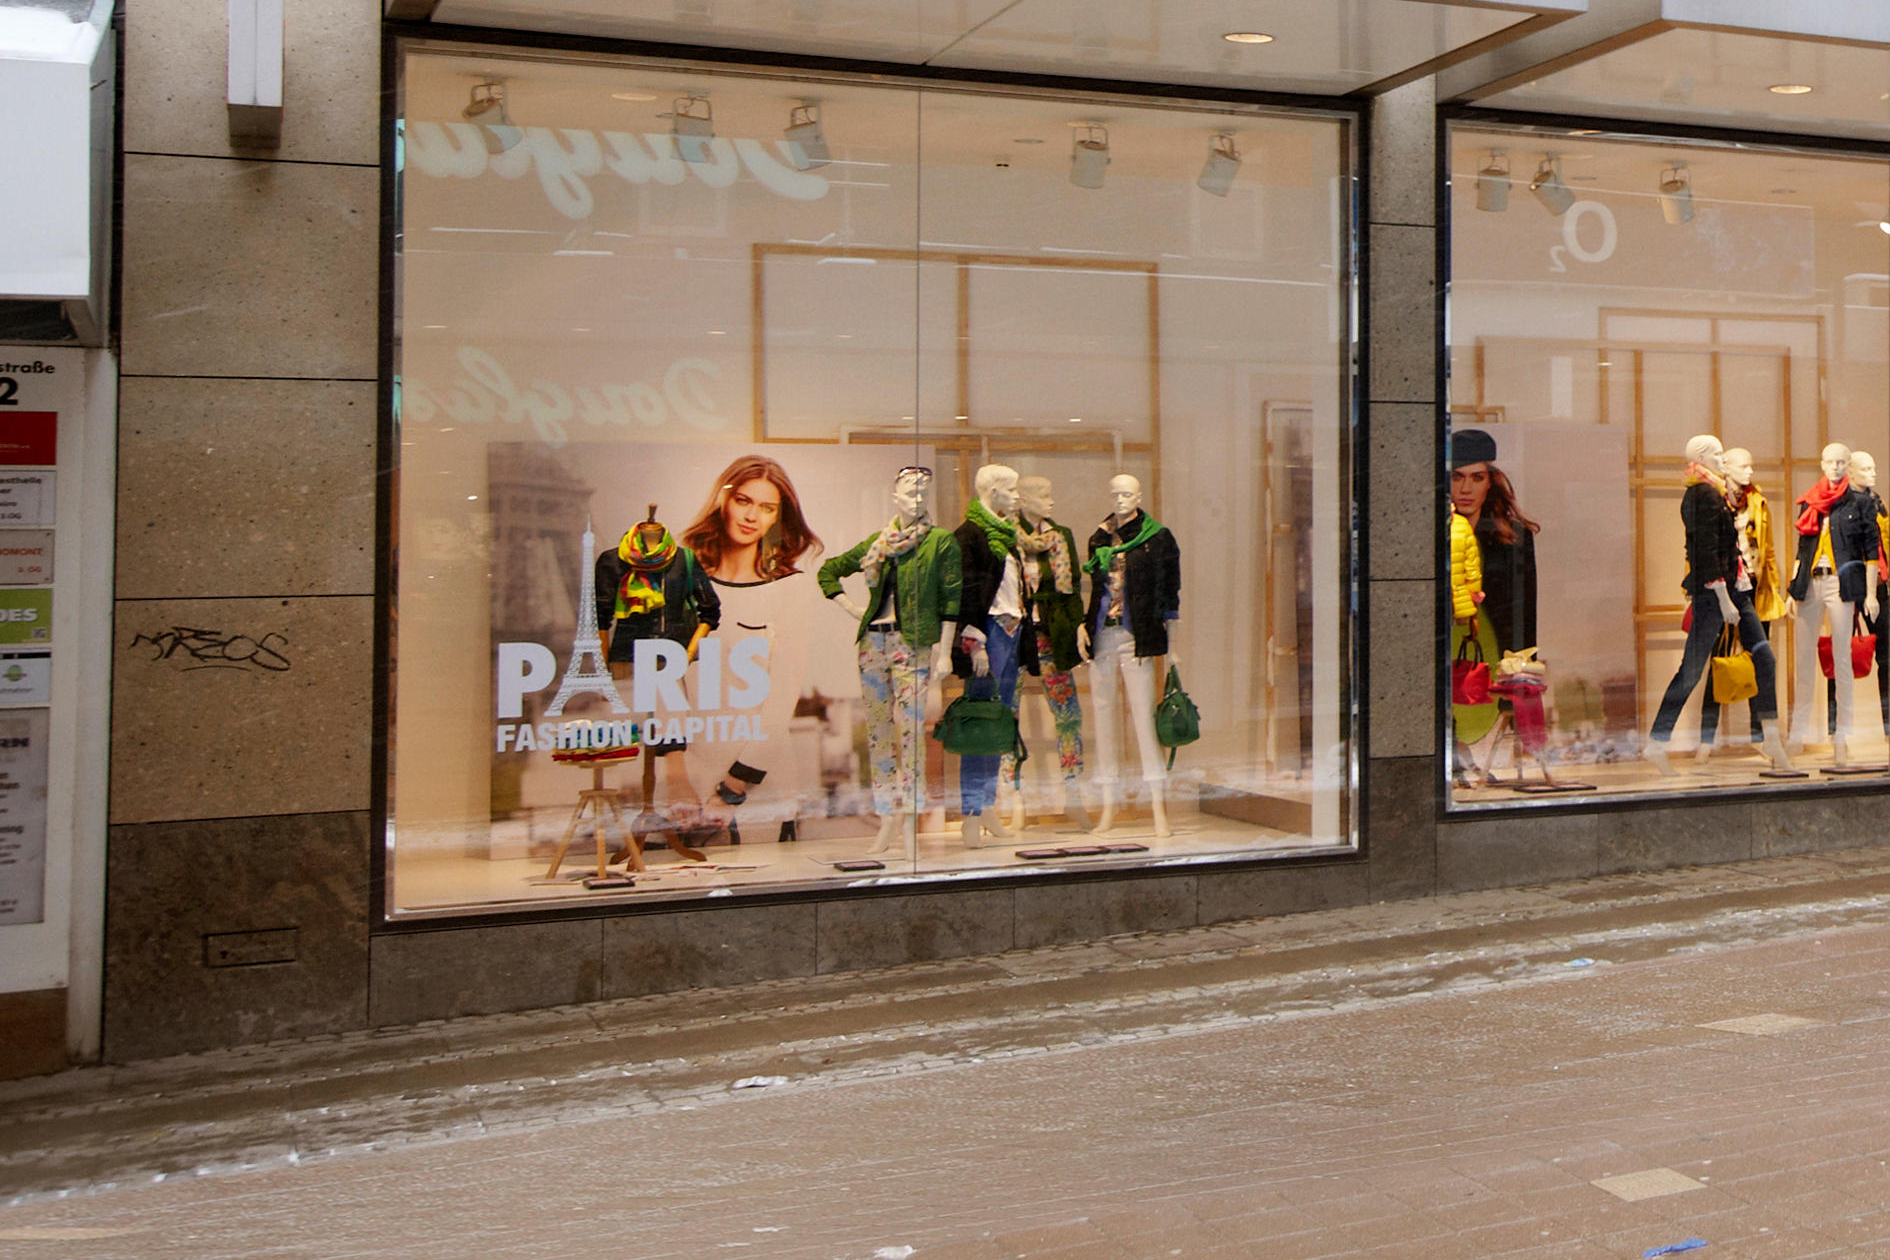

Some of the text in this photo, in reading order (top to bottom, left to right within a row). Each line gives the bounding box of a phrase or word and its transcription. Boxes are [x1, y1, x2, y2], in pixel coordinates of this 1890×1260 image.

[497, 636, 772, 719] PARIS
[497, 714, 769, 753] FASHION CAPITAL
